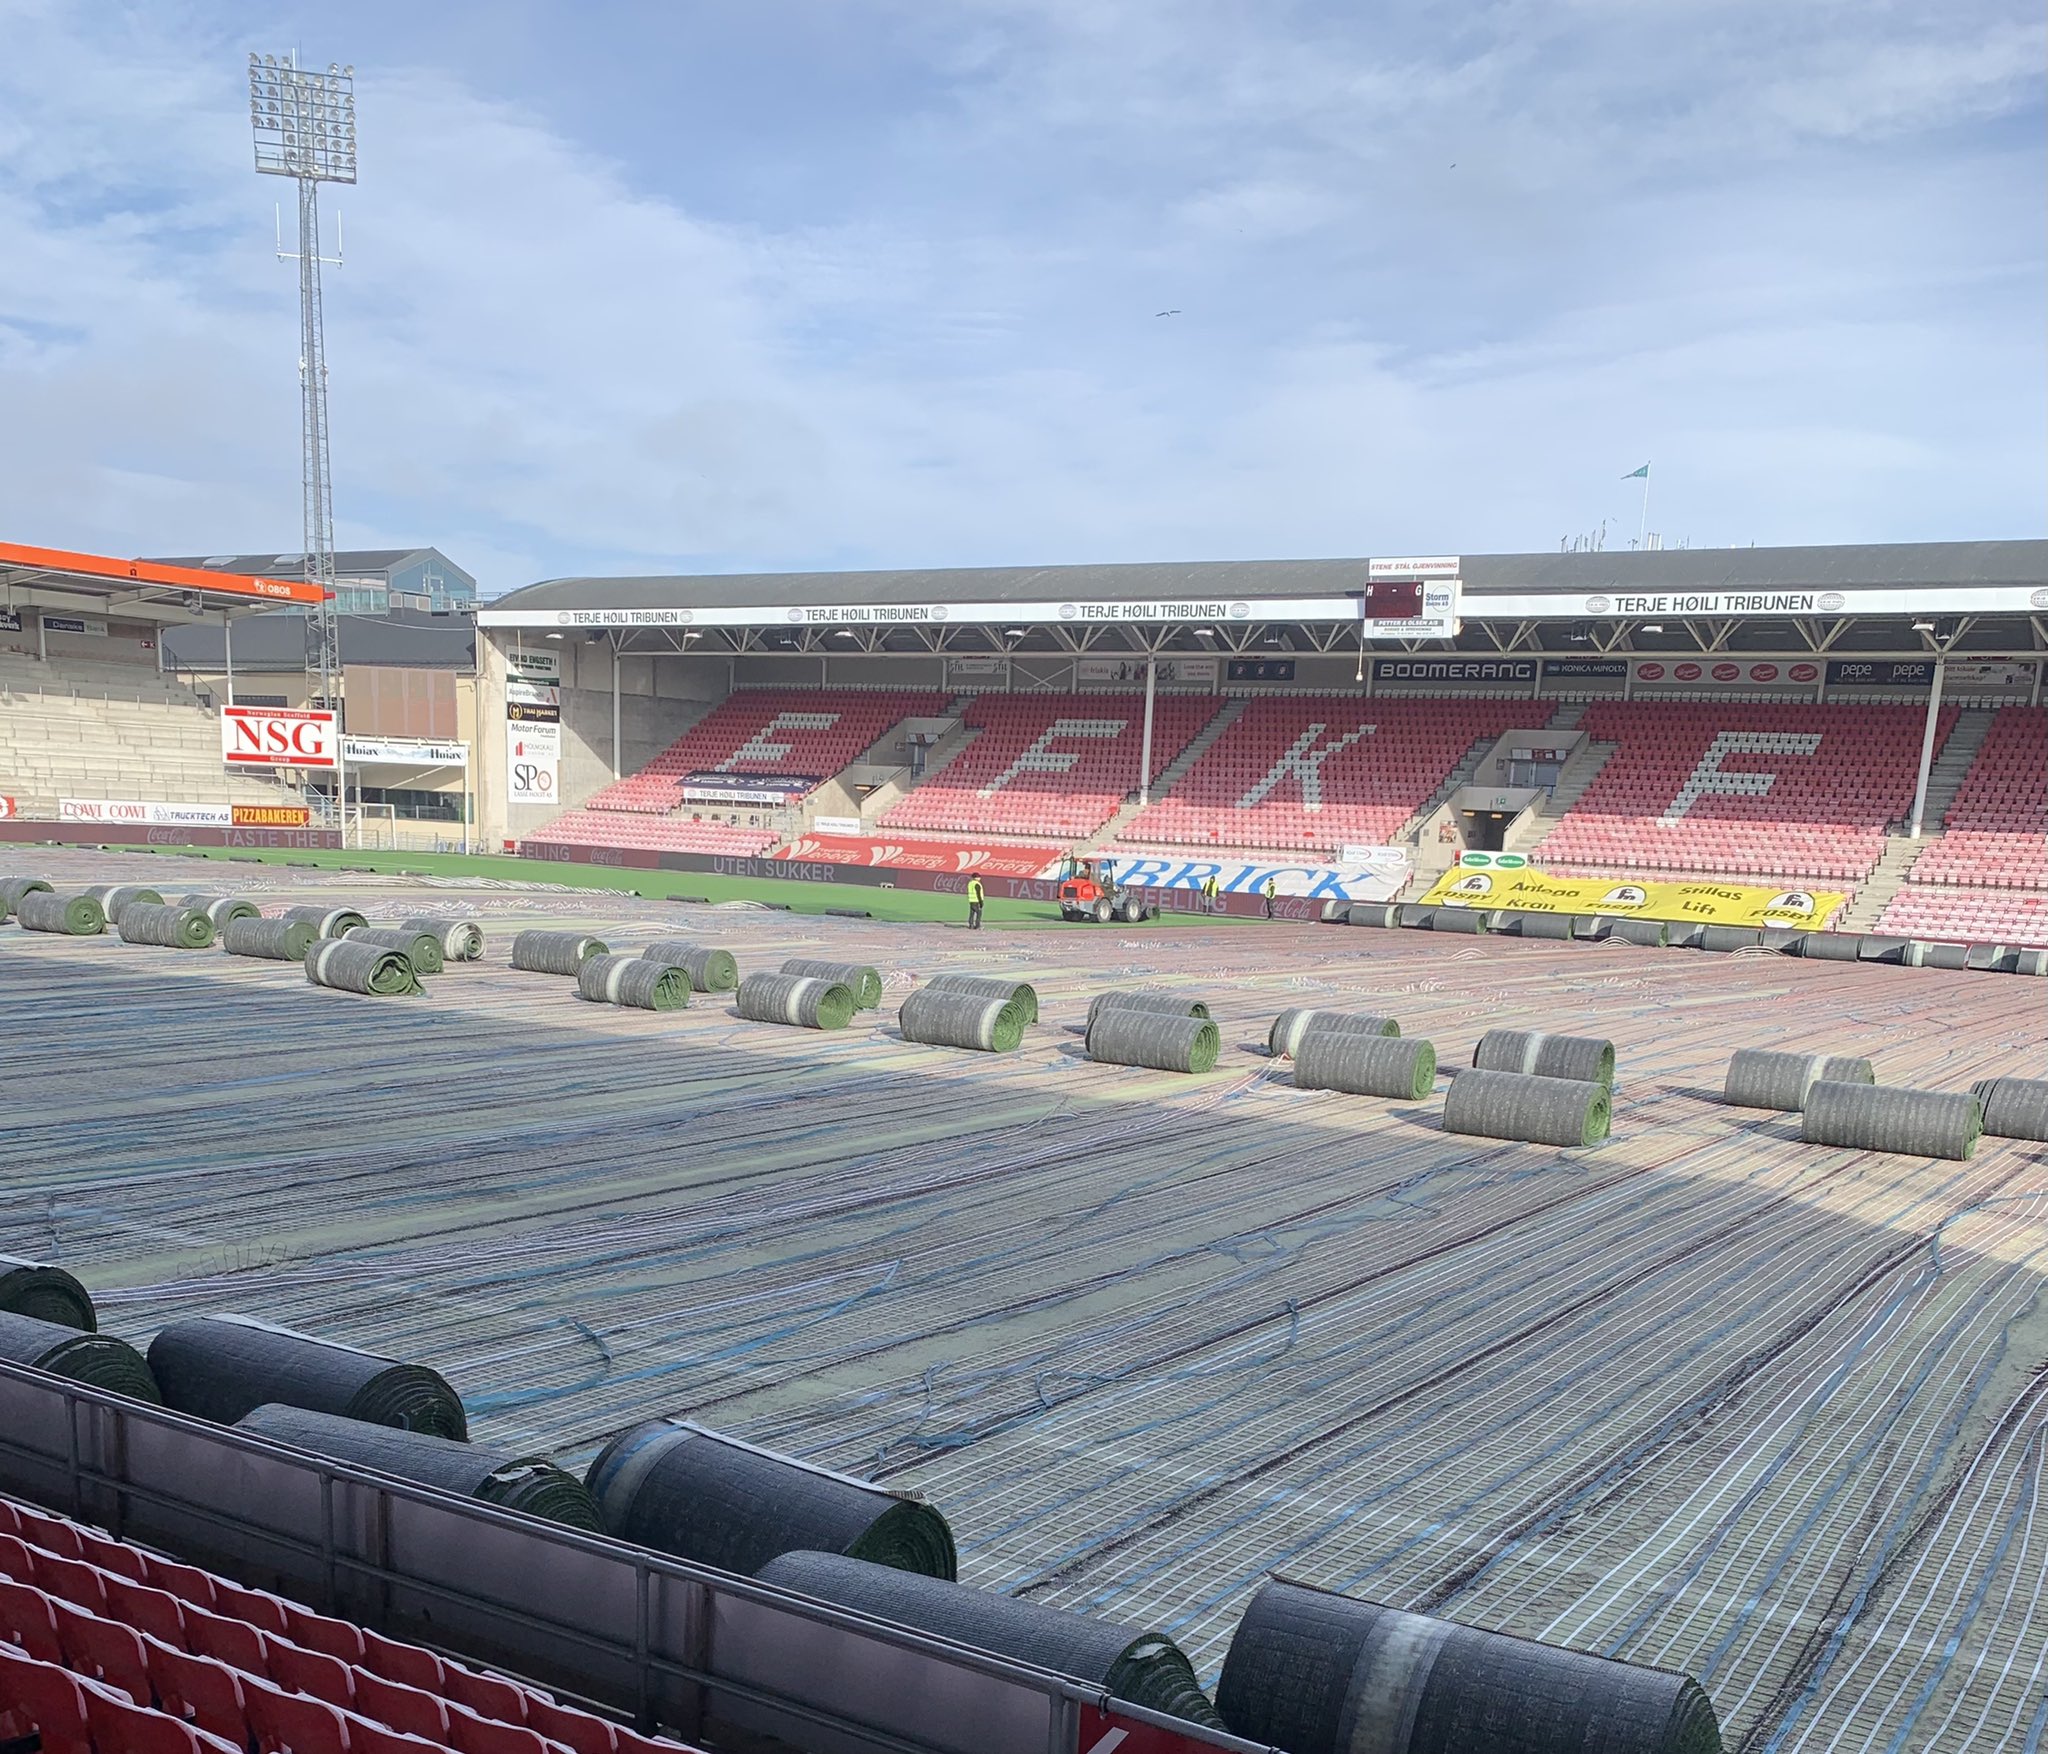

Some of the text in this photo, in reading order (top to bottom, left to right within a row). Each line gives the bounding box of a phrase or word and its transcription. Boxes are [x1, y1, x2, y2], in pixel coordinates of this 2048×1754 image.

[267, 584, 291, 595] OBOS
[1366, 585, 1374, 596] H
[1415, 584, 1423, 596] G
[1425, 592, 1449, 601] Storm
[1615, 595, 1814, 612] TERJE HØILI TRIBUNEN
[573, 612, 601, 624] TERJE
[630, 611, 678, 623] TRIBUNEN
[805, 609, 838, 621] TERJE
[841, 609, 870, 621] HØILI
[873, 608, 928, 620] TRIBUNEN
[1080, 605, 1119, 618] TERJE
[1122, 604, 1157, 618] HØILI
[1160, 604, 1226, 618] TRIBUNEN
[1380, 662, 1531, 678] BOOMERANG
[1561, 664, 1626, 673] KONICA MINOLTA
[1840, 664, 1872, 678] pepe
[1892, 664, 1925, 678] pepe
[511, 723, 556, 735] Motor Forum
[232, 718, 324, 755] NSG
[64, 802, 102, 818] COWI
[109, 804, 147, 819] COWI
[170, 811, 230, 822] TRUCKTECH AS
[233, 807, 305, 824] PIZZABAKEREN
[221, 829, 278, 848] TASTE
[284, 831, 320, 849] THE
[713, 857, 835, 881] UTEN SUKKER
[980, 861, 1038, 874] energi
[1678, 886, 1743, 901] Stillas
[1506, 898, 1556, 911] Kran
[1682, 900, 1716, 915] Lift
